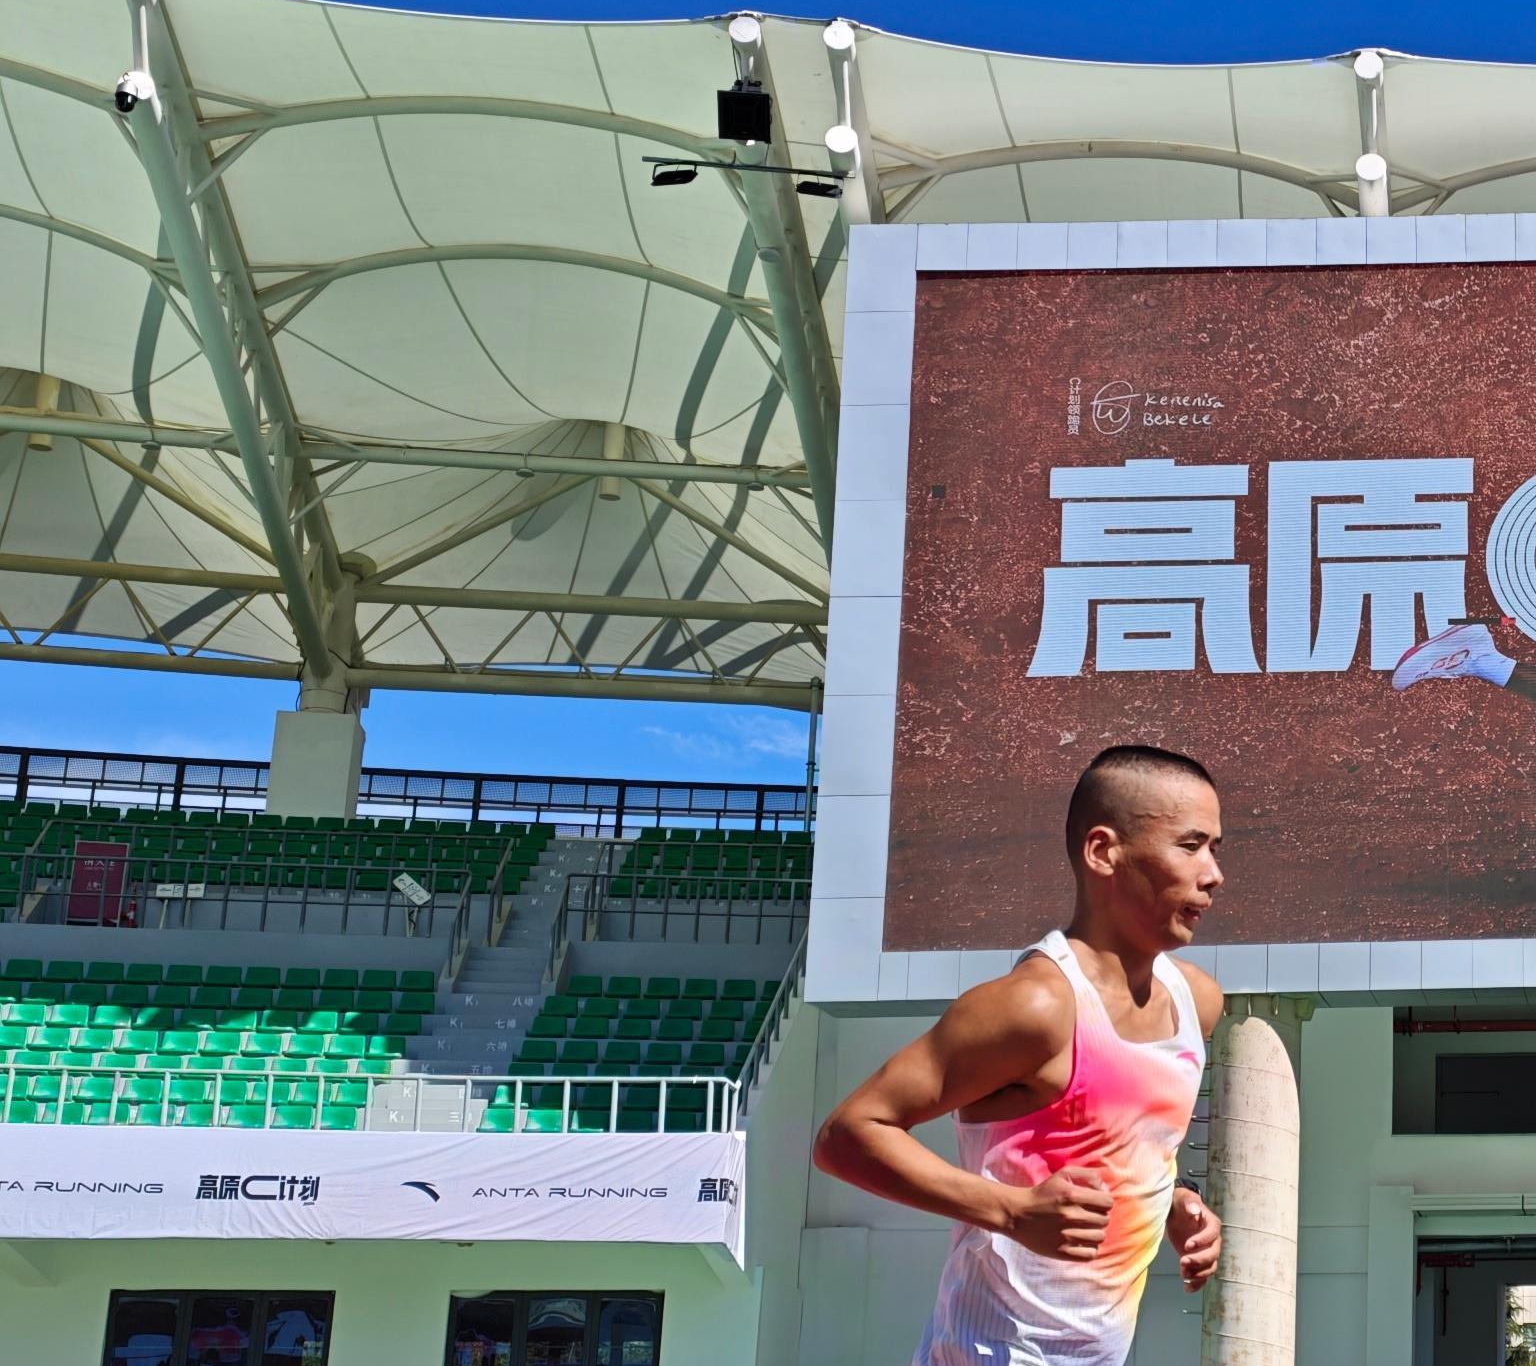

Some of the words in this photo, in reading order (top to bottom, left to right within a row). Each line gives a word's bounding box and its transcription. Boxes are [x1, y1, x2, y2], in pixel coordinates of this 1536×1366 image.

[34, 1181, 164, 1194] RUNNING
[196, 1174, 320, 1201] 高原C计划
[472, 1187, 540, 1198] ANTA
[548, 1187, 668, 1198] RUNNING
